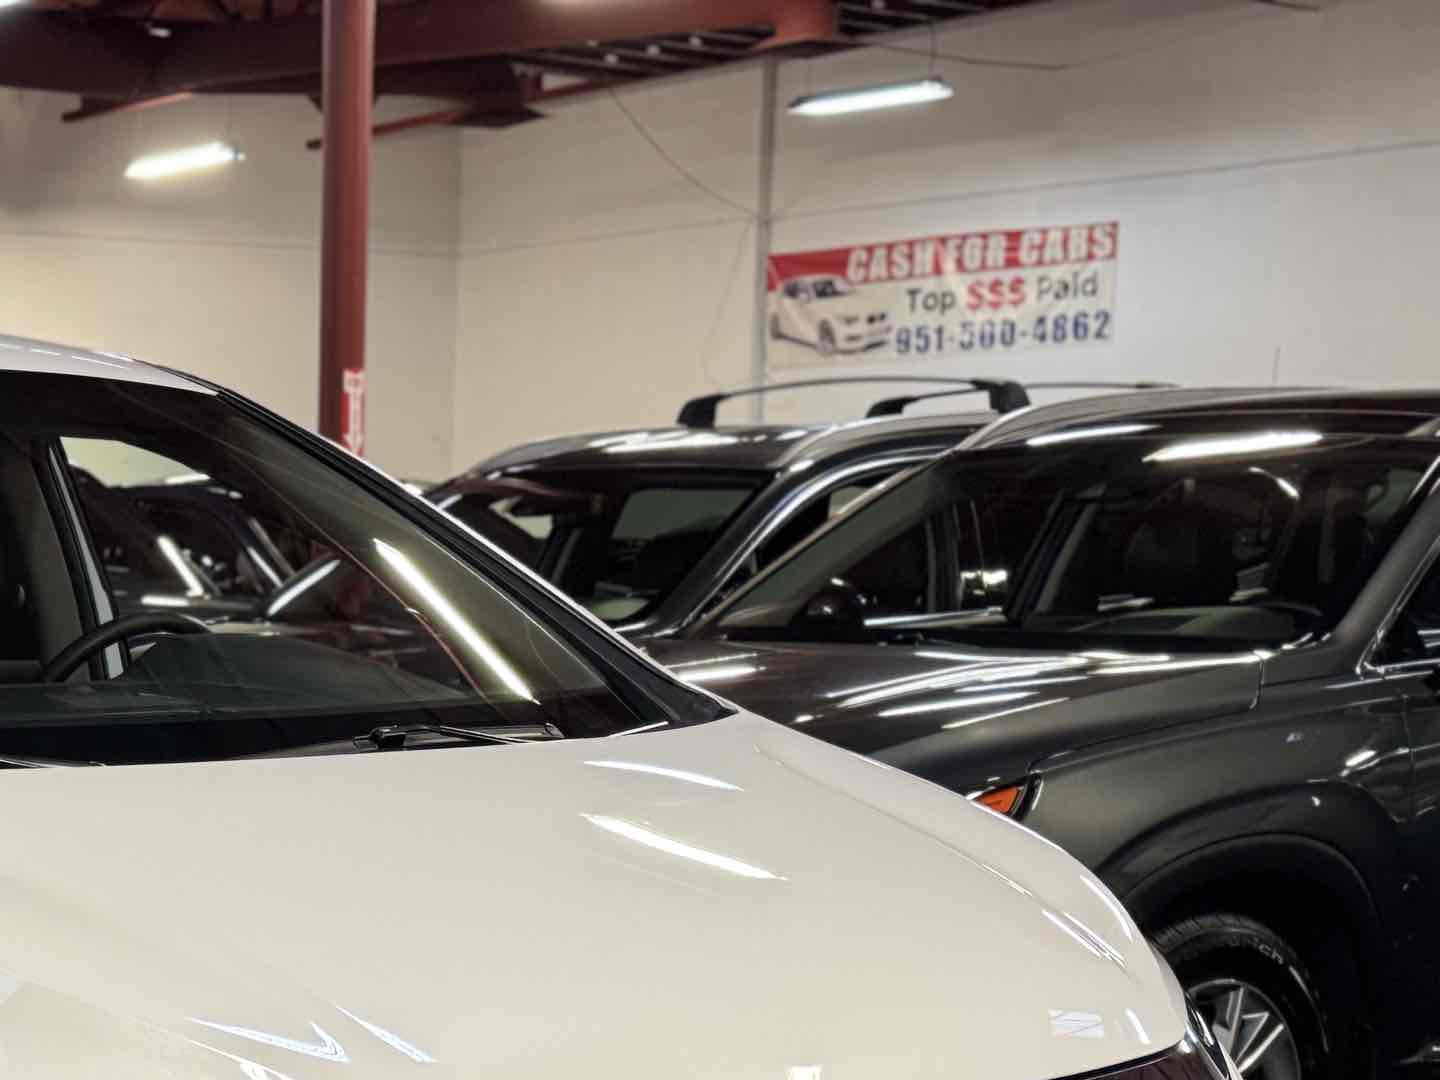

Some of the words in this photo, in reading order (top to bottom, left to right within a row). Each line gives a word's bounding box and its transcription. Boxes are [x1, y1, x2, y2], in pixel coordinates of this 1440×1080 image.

[847, 238, 939, 281] CASH
[948, 230, 1008, 272] FOR
[1016, 223, 1116, 265] CARS
[906, 286, 957, 313] Top
[966, 276, 1026, 311] $$$
[1036, 271, 1099, 299] Paid
